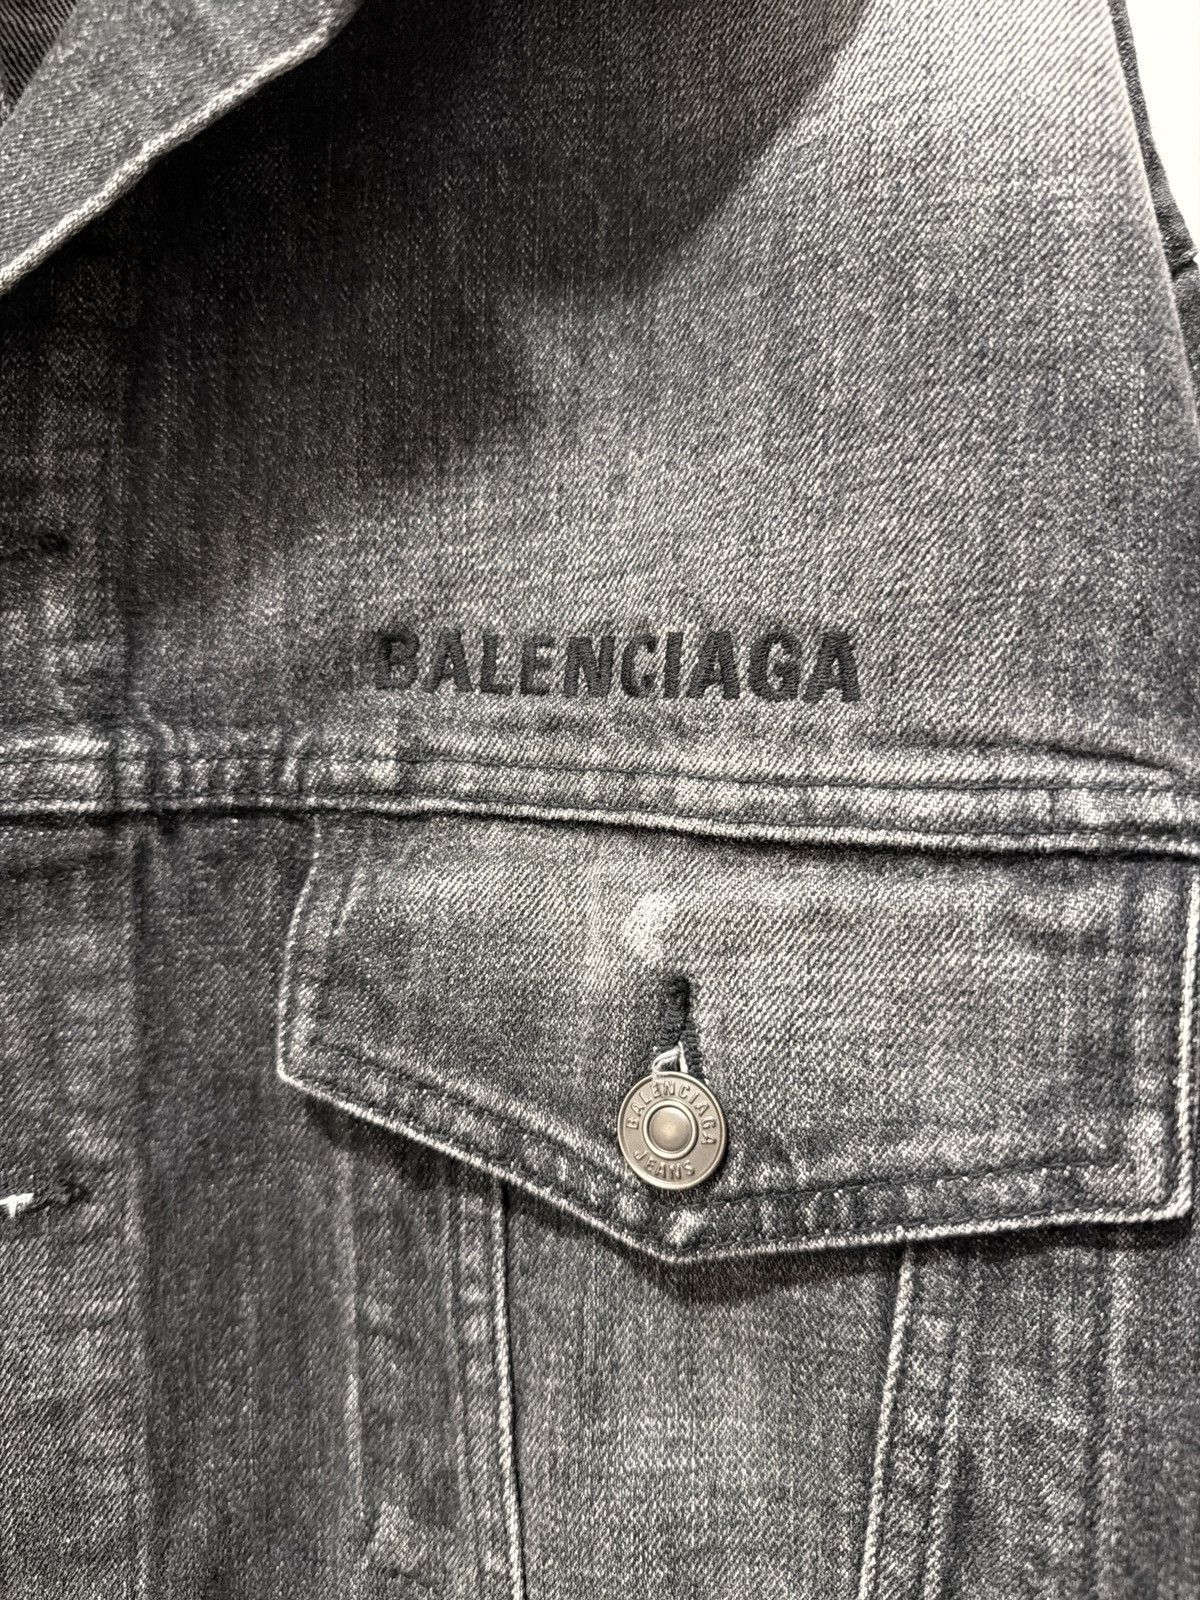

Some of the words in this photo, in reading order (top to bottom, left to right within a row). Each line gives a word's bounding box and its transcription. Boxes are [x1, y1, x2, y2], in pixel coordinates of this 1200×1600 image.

[374, 628, 861, 702] BALENCIAGA
[626, 1080, 717, 1145] BALENCIAGA
[633, 1149, 696, 1179] JEANS
